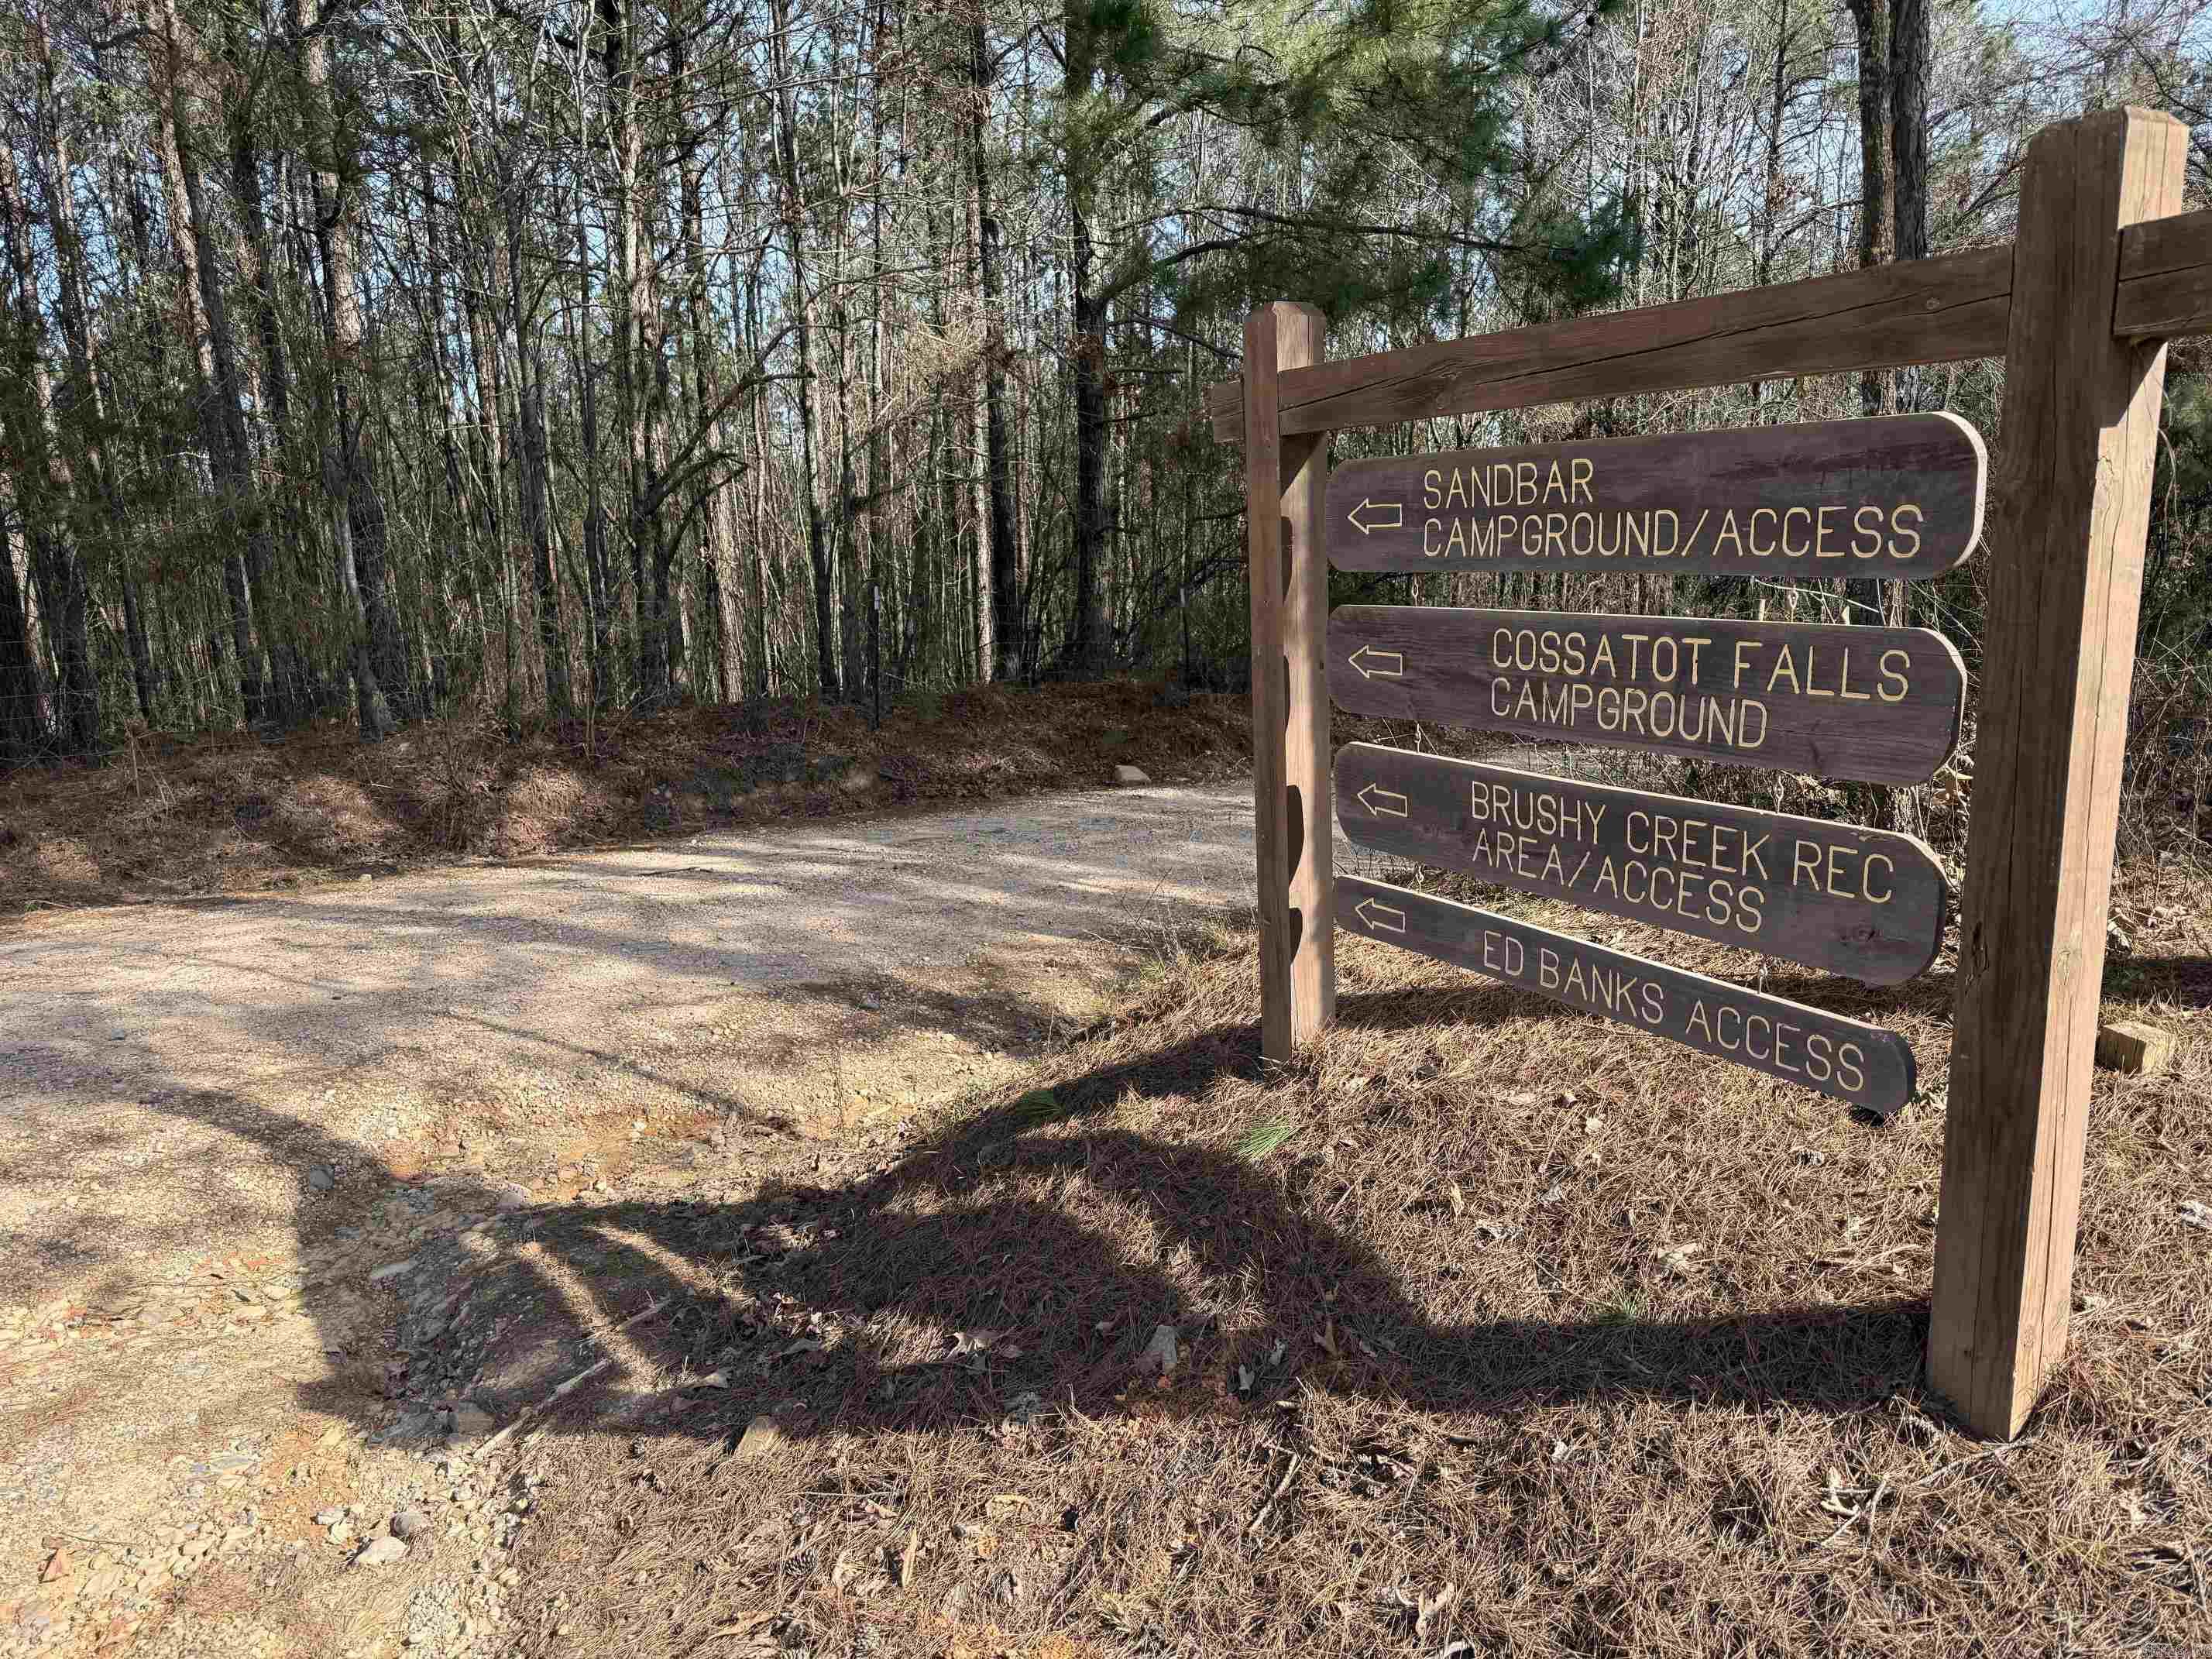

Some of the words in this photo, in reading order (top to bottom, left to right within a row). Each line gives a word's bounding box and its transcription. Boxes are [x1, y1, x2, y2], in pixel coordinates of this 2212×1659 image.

[1423, 459, 1593, 509] SANDBAR
[1423, 504, 1924, 558] CAMPGROUND/ACCESS
[1492, 628, 1712, 686] COSSATOT
[1735, 642, 1909, 702] FALLS
[1491, 676, 1767, 749] CAMPGROUND
[1472, 781, 1606, 844] BRUSHY
[1626, 811, 1772, 880] CREEK
[1793, 839, 1894, 905] REC
[1472, 828, 1764, 933] AREA/ACCESS
[1484, 930, 1524, 977] ED
[1540, 947, 1664, 1025] BANKS
[1686, 1000, 1865, 1093] ACCESS
